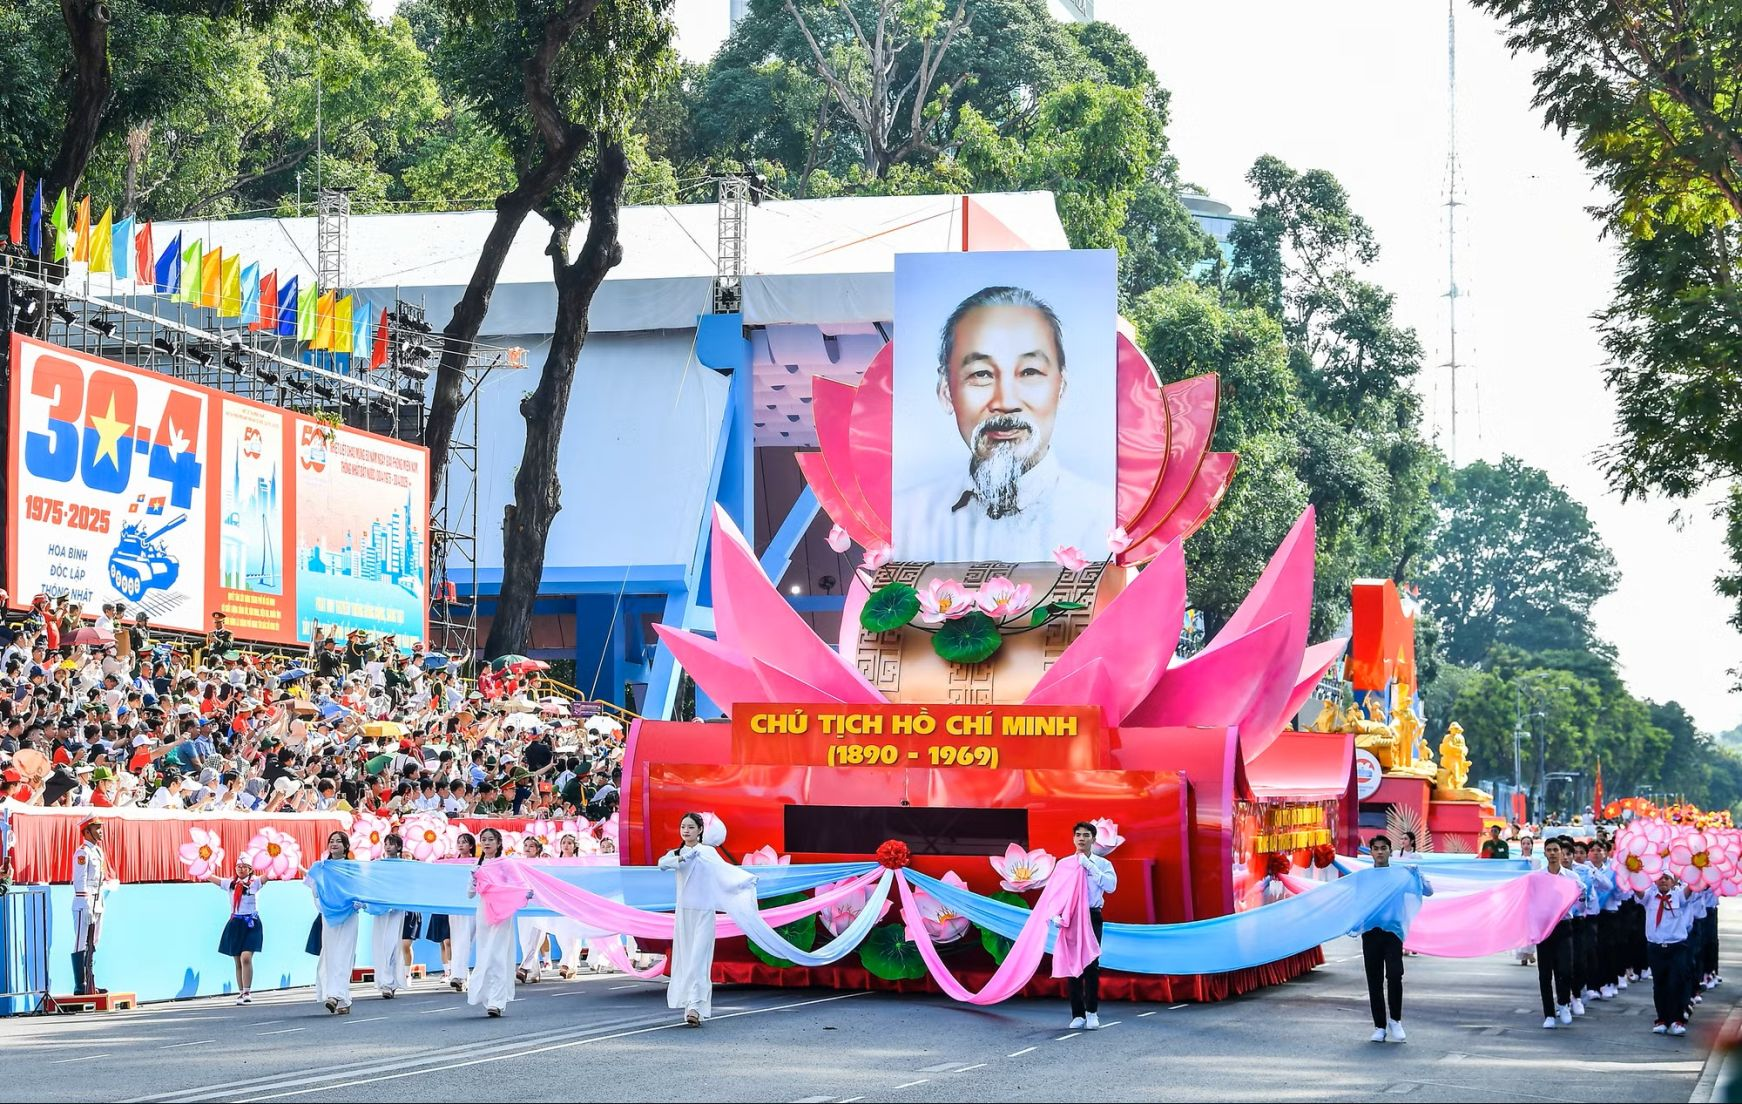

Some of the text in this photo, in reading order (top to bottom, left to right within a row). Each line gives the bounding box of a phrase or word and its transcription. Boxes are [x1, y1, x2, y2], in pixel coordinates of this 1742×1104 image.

[750, 707, 1078, 739] CHỦ TỊCH HỒ CHÍ MINH
[827, 744, 898, 768] (1890
[928, 746, 999, 769] 1969)
